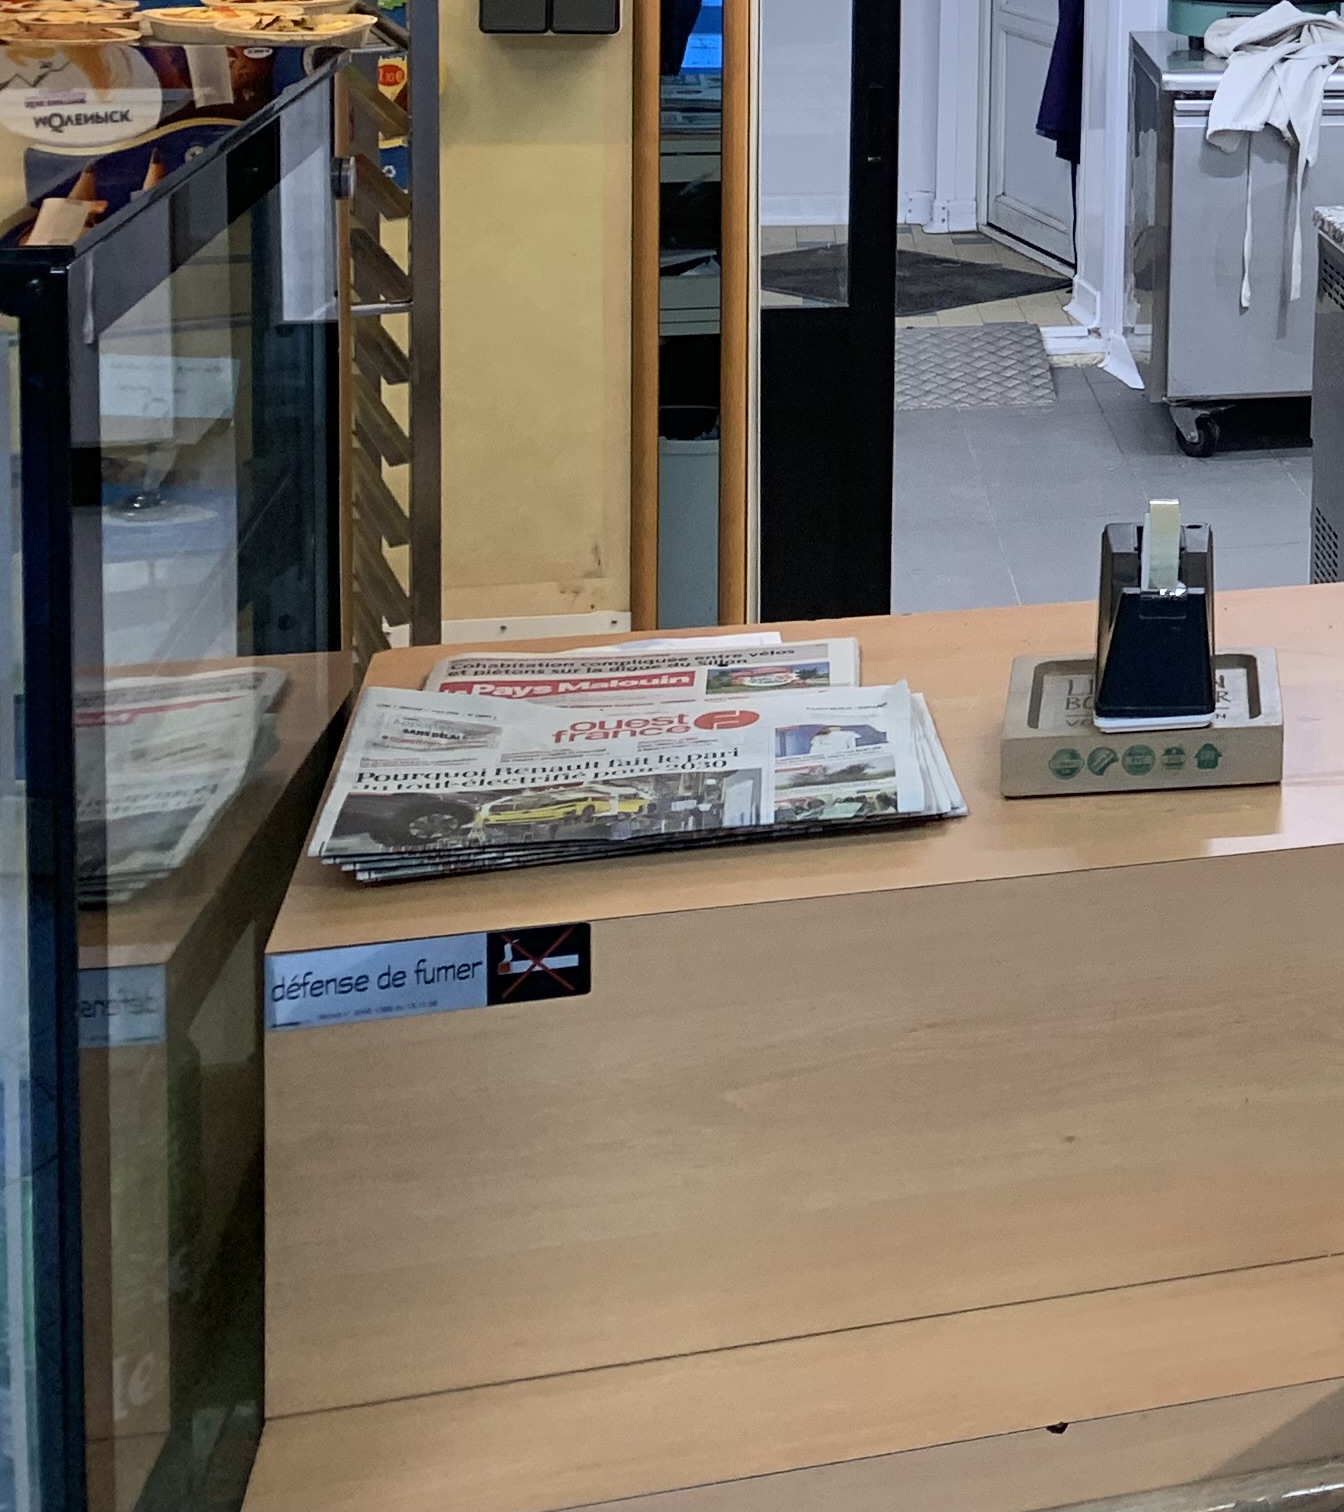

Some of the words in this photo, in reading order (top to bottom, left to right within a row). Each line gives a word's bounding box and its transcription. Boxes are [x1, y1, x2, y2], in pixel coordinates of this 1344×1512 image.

[450, 661, 575, 670] Cohabitation
[580, 656, 689, 669] compliquée
[694, 653, 743, 661] entre
[749, 649, 795, 657] vélos
[473, 668, 545, 677] piétons
[586, 666, 602, 674] la
[608, 664, 666, 674] digue
[671, 661, 691, 669] du
[471, 683, 553, 698] Pays
[557, 675, 690, 693] Malouin
[569, 714, 690, 732] ouest
[551, 724, 692, 744] france
[356, 767, 487, 783] Pourquoi
[494, 760, 600, 778] Renault
[607, 757, 648, 769] fait
[657, 754, 681, 764] le
[685, 747, 740, 765] pari
[271, 972, 369, 1002] défense
[377, 964, 407, 990] de
[414, 958, 484, 985] fumer
